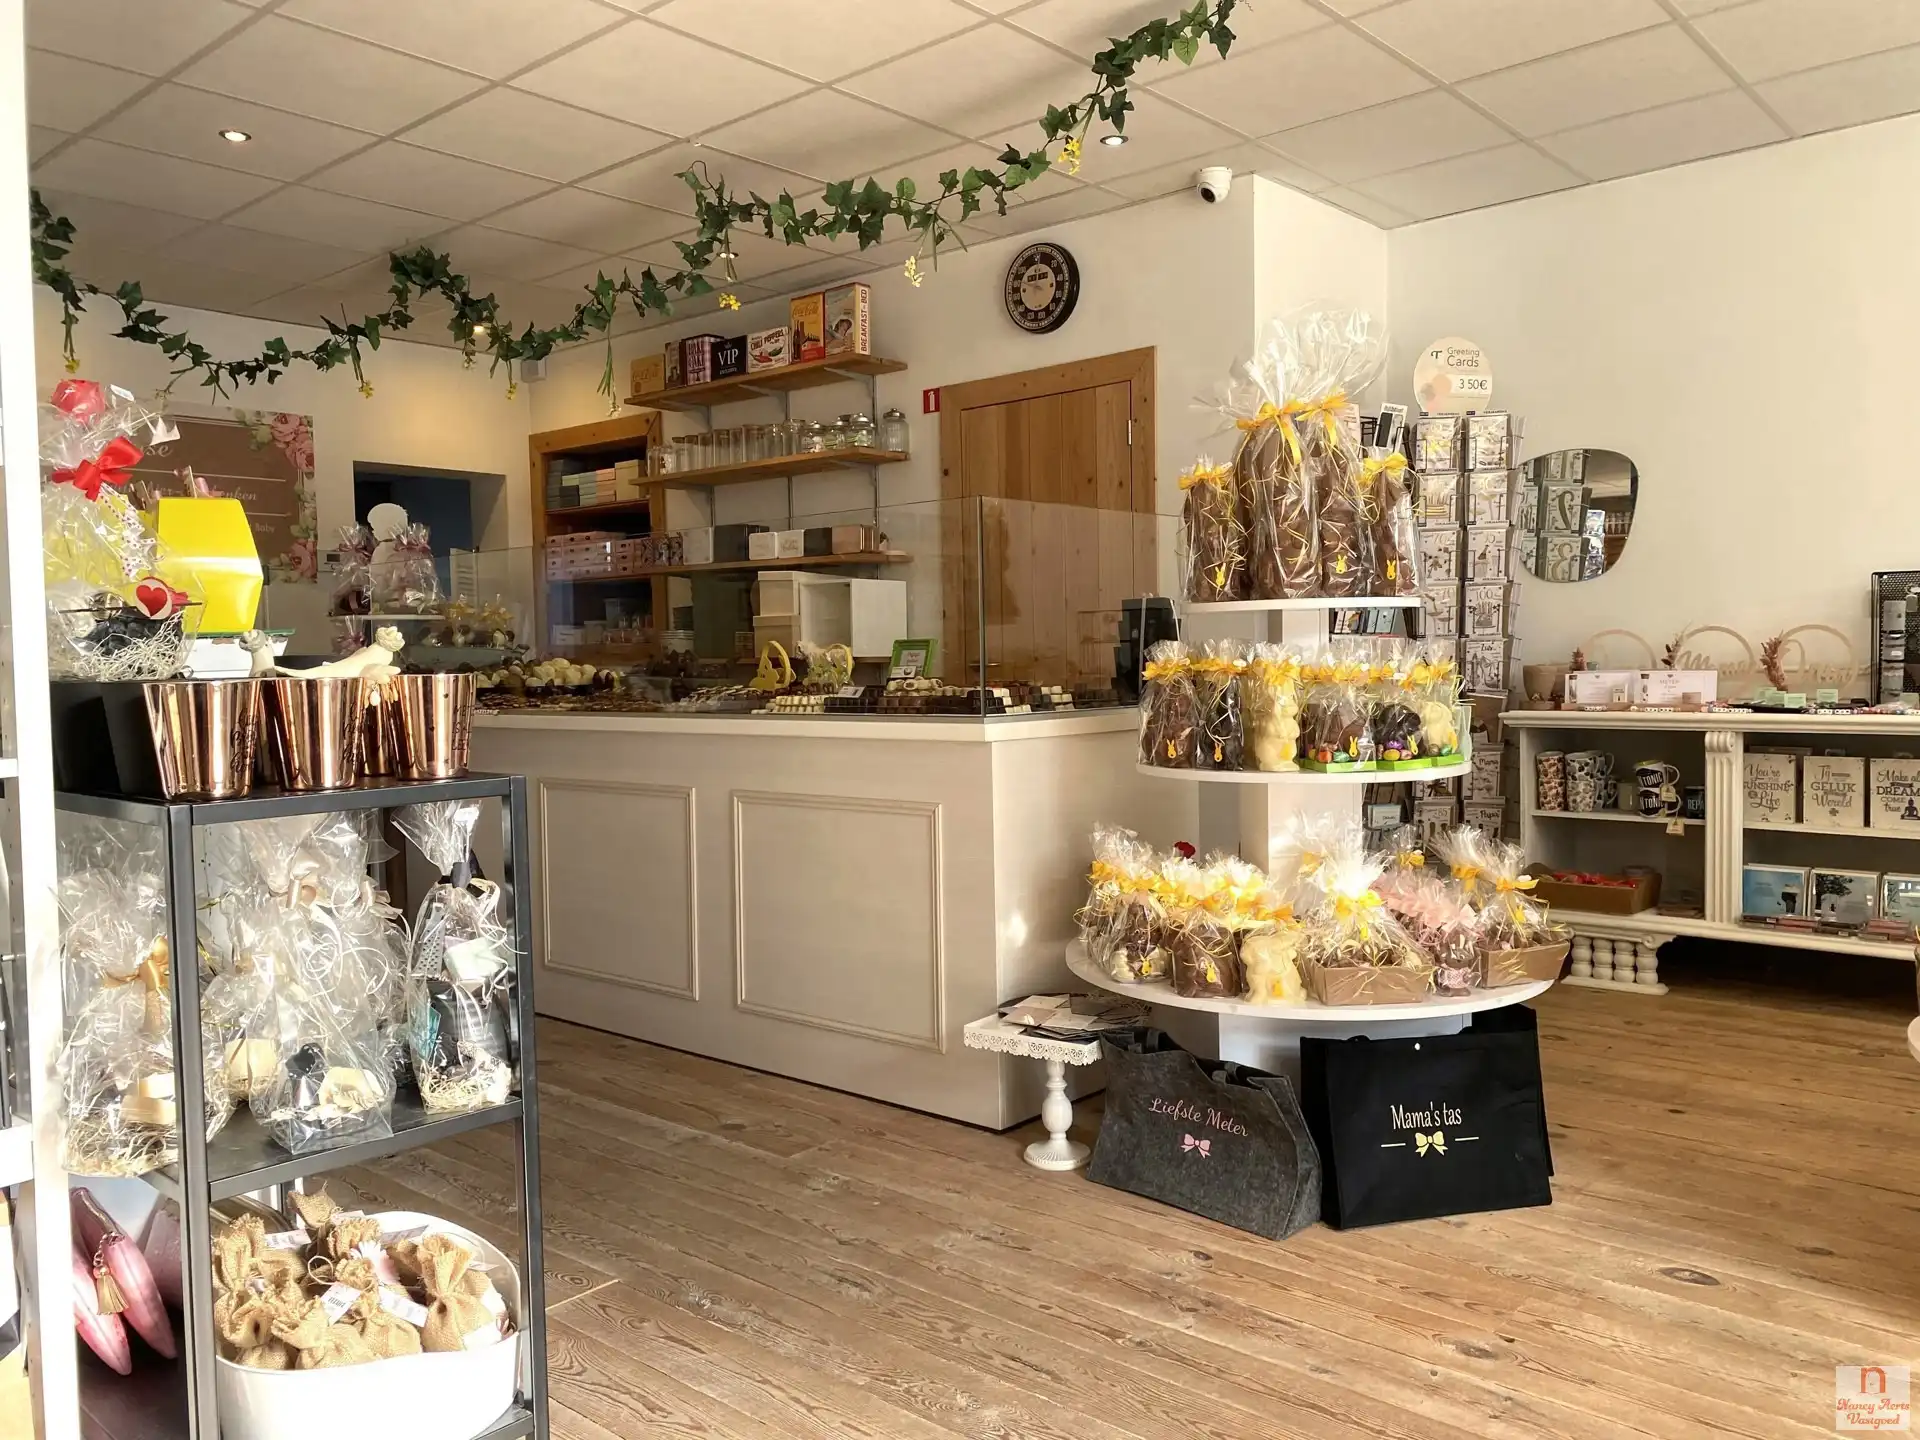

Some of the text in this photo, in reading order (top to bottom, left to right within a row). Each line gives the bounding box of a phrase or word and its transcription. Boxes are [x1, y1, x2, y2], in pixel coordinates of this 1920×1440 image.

[718, 348, 739, 366] VIP
[1447, 346, 1480, 358] Greeting
[1446, 354, 1480, 367] Cards
[255, 522, 276, 534] Baby
[1642, 771, 1664, 787] TONIC
[1744, 763, 1781, 781] You're
[1877, 768, 1909, 783] Make
[1810, 782, 1856, 793] GELUK
[1750, 791, 1781, 812] Life
[1811, 792, 1852, 807] Wereld
[1148, 1097, 1249, 1138] Liefste Meter
[1391, 1101, 1462, 1130] Mama's tas
